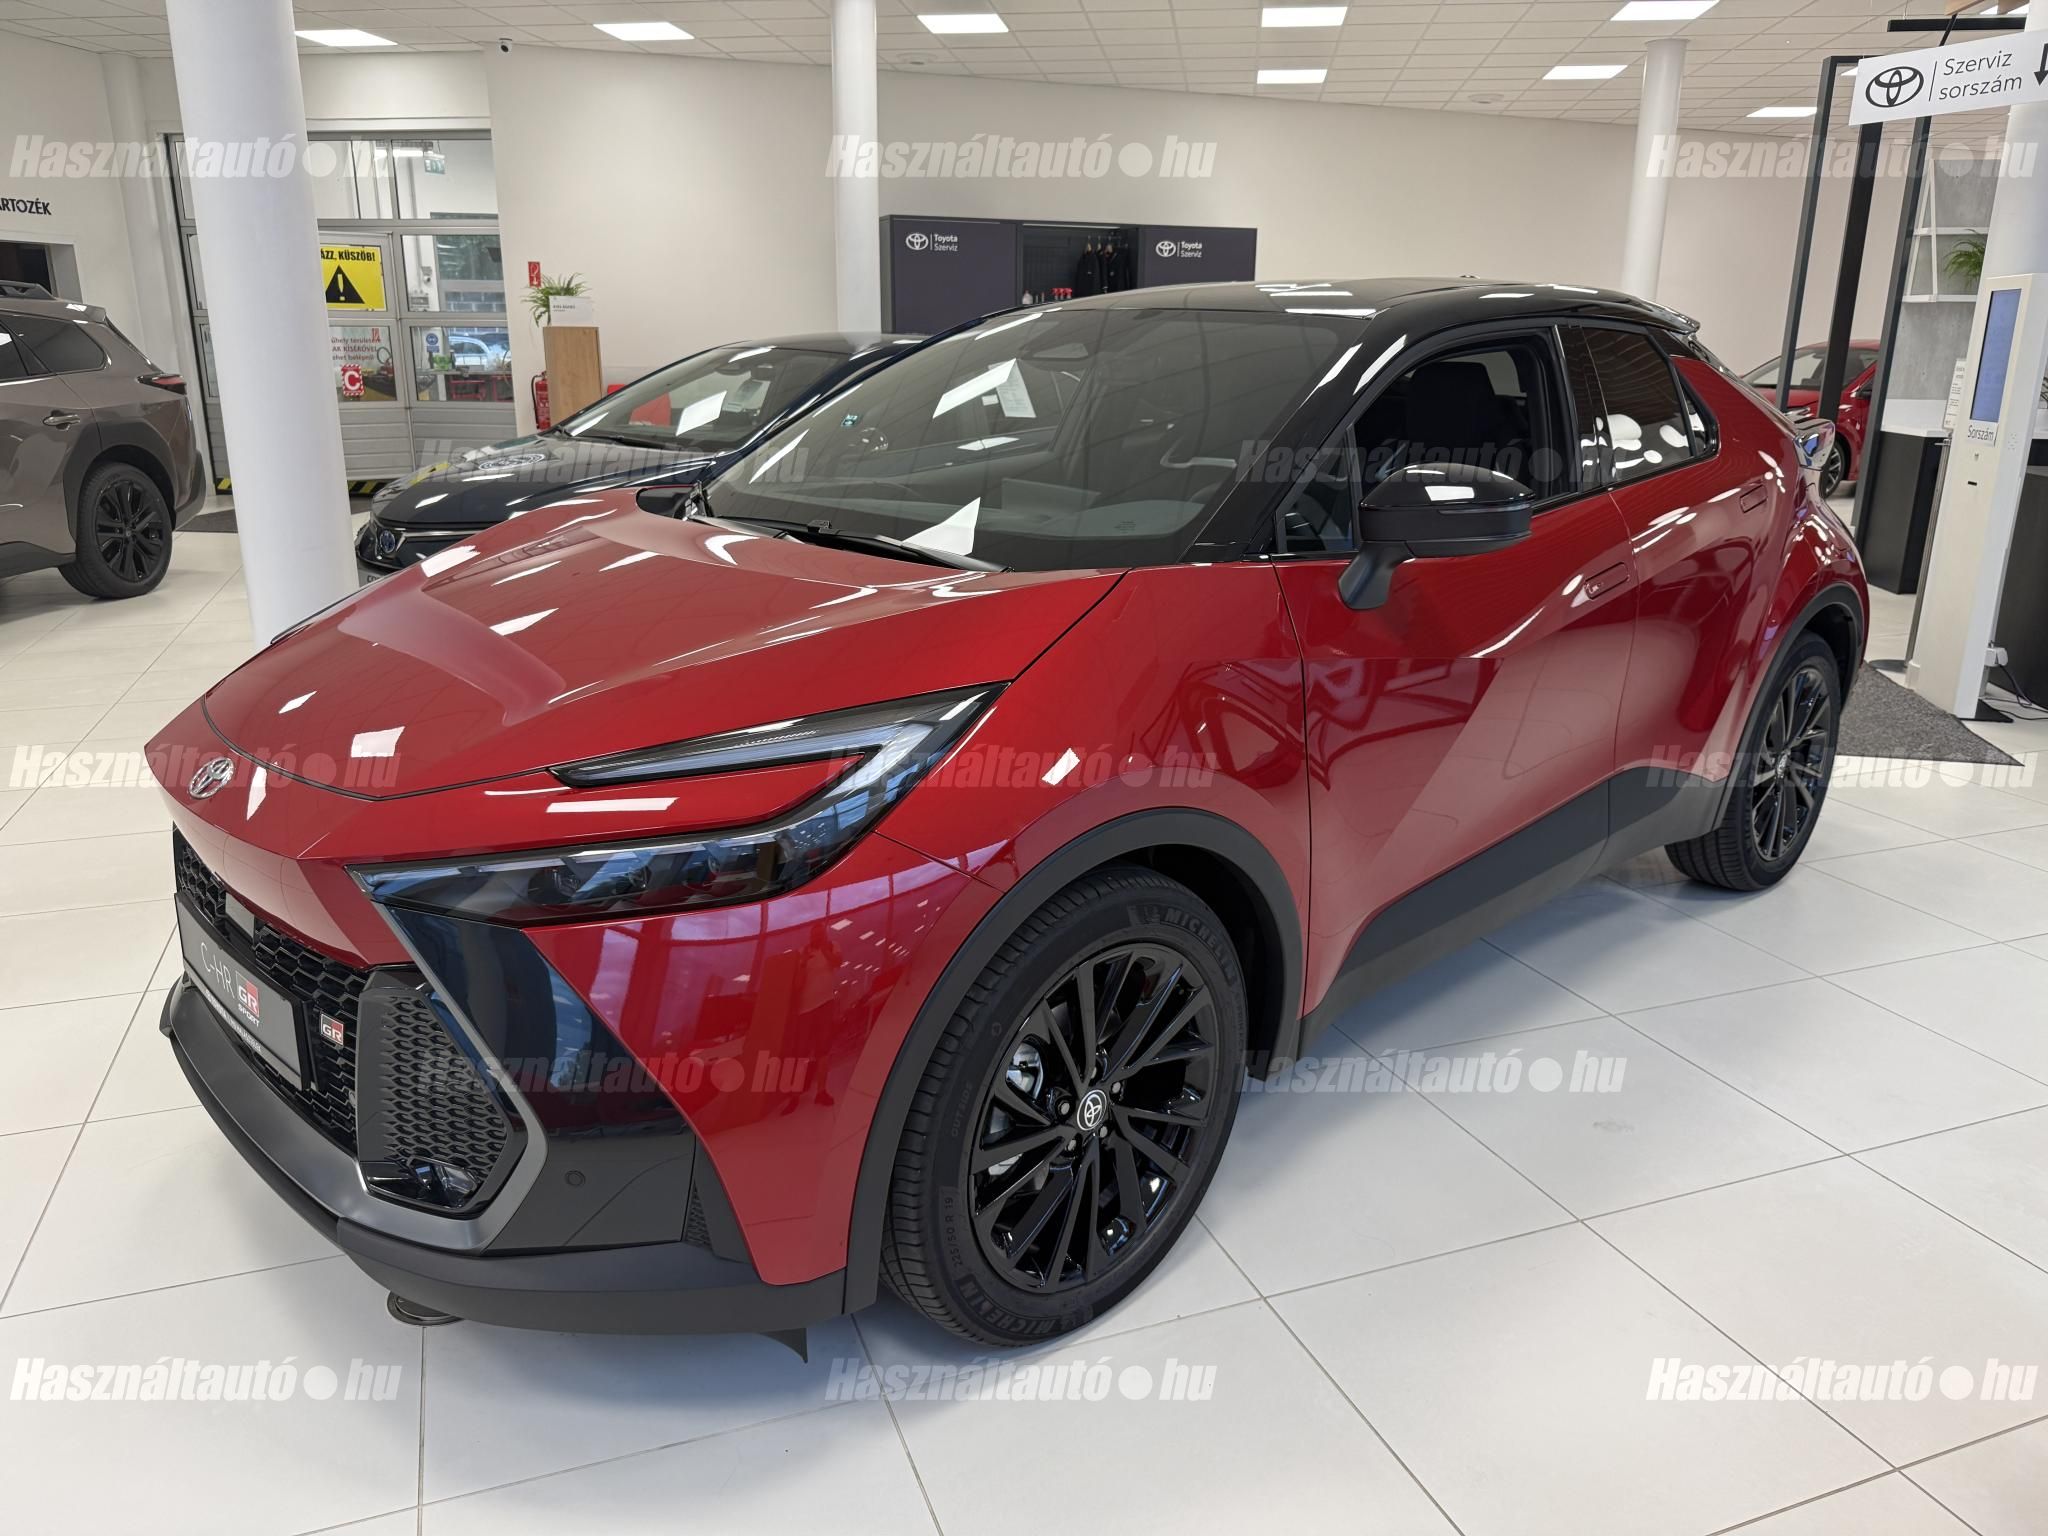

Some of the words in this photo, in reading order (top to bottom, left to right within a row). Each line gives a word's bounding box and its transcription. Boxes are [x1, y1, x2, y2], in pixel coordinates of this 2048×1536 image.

[1943, 50, 2013, 75] Szerviz
[1939, 75, 2022, 100] sorszám
[0, 197, 51, 215] RTOZÉK
[934, 233, 958, 243] Toyota
[934, 243, 958, 251] Szerviz
[1180, 241, 1202, 250] Toyota
[320, 248, 337, 261] ÁZZ,
[338, 249, 376, 262] KÜSZÖB!
[1968, 424, 1994, 441] Sorszám
[200, 942, 235, 999] C-HR
[238, 985, 258, 1014] GR
[237, 1003, 260, 1028] SPORT
[322, 1023, 343, 1042] GR
